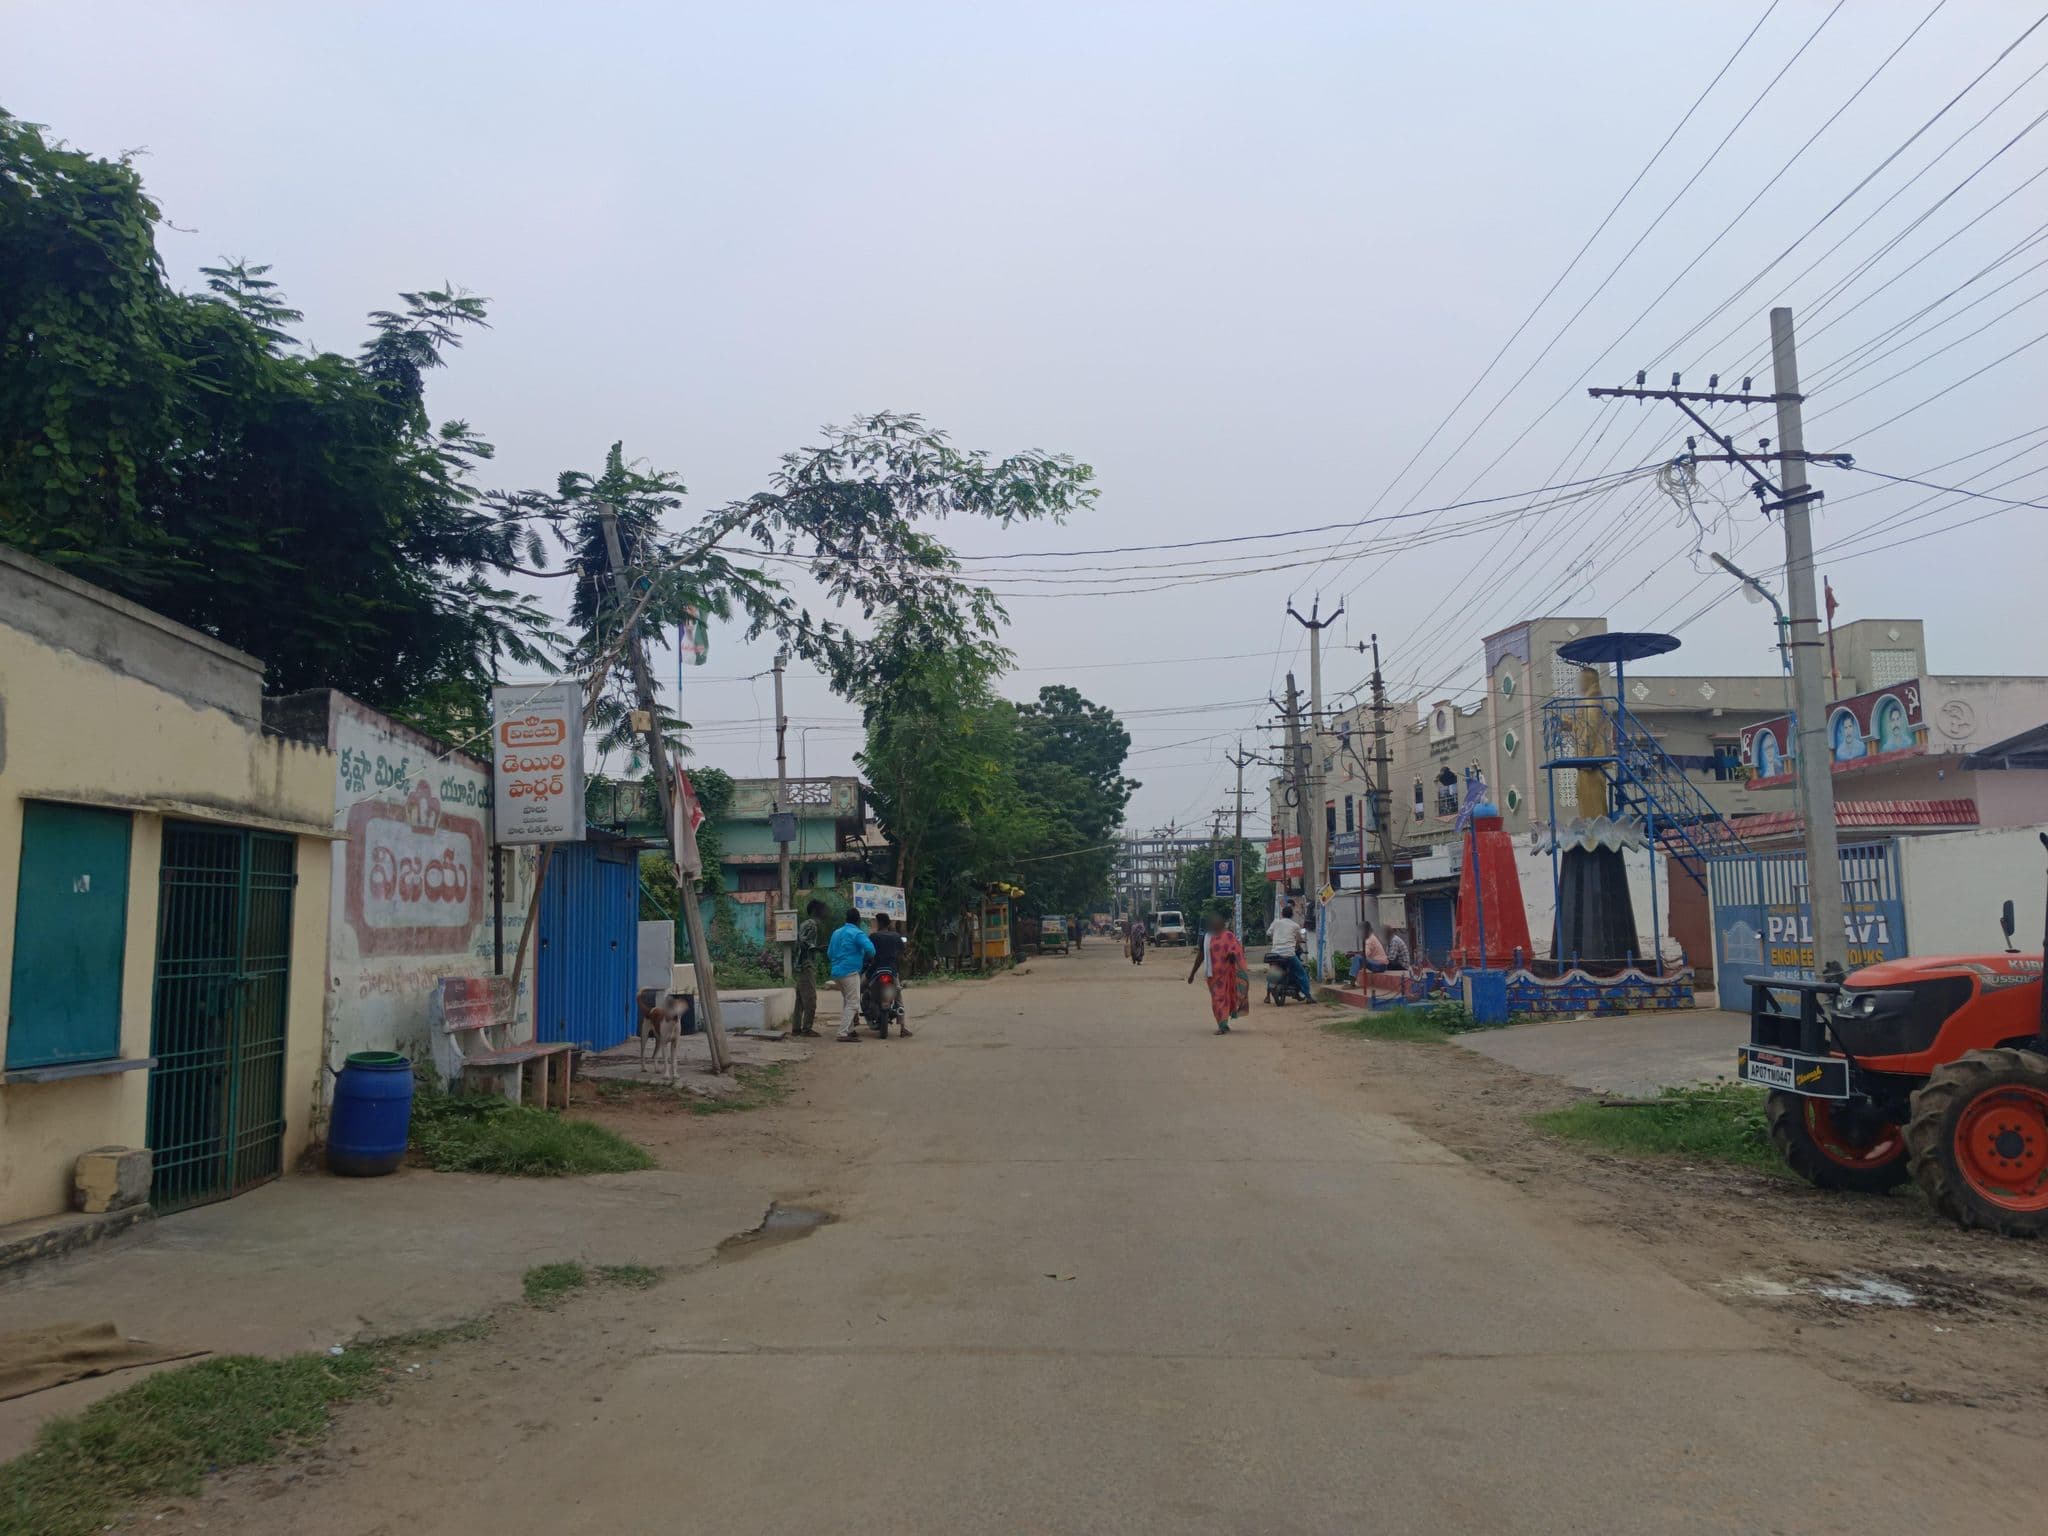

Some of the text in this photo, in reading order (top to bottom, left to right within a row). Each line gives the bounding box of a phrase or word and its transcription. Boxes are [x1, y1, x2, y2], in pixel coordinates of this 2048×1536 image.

[509, 774, 564, 803] పార్లర్
[369, 846, 468, 904] విజయ
[1767, 915, 1890, 943] PALAVI
[1771, 948, 1815, 967] ENGINEE
